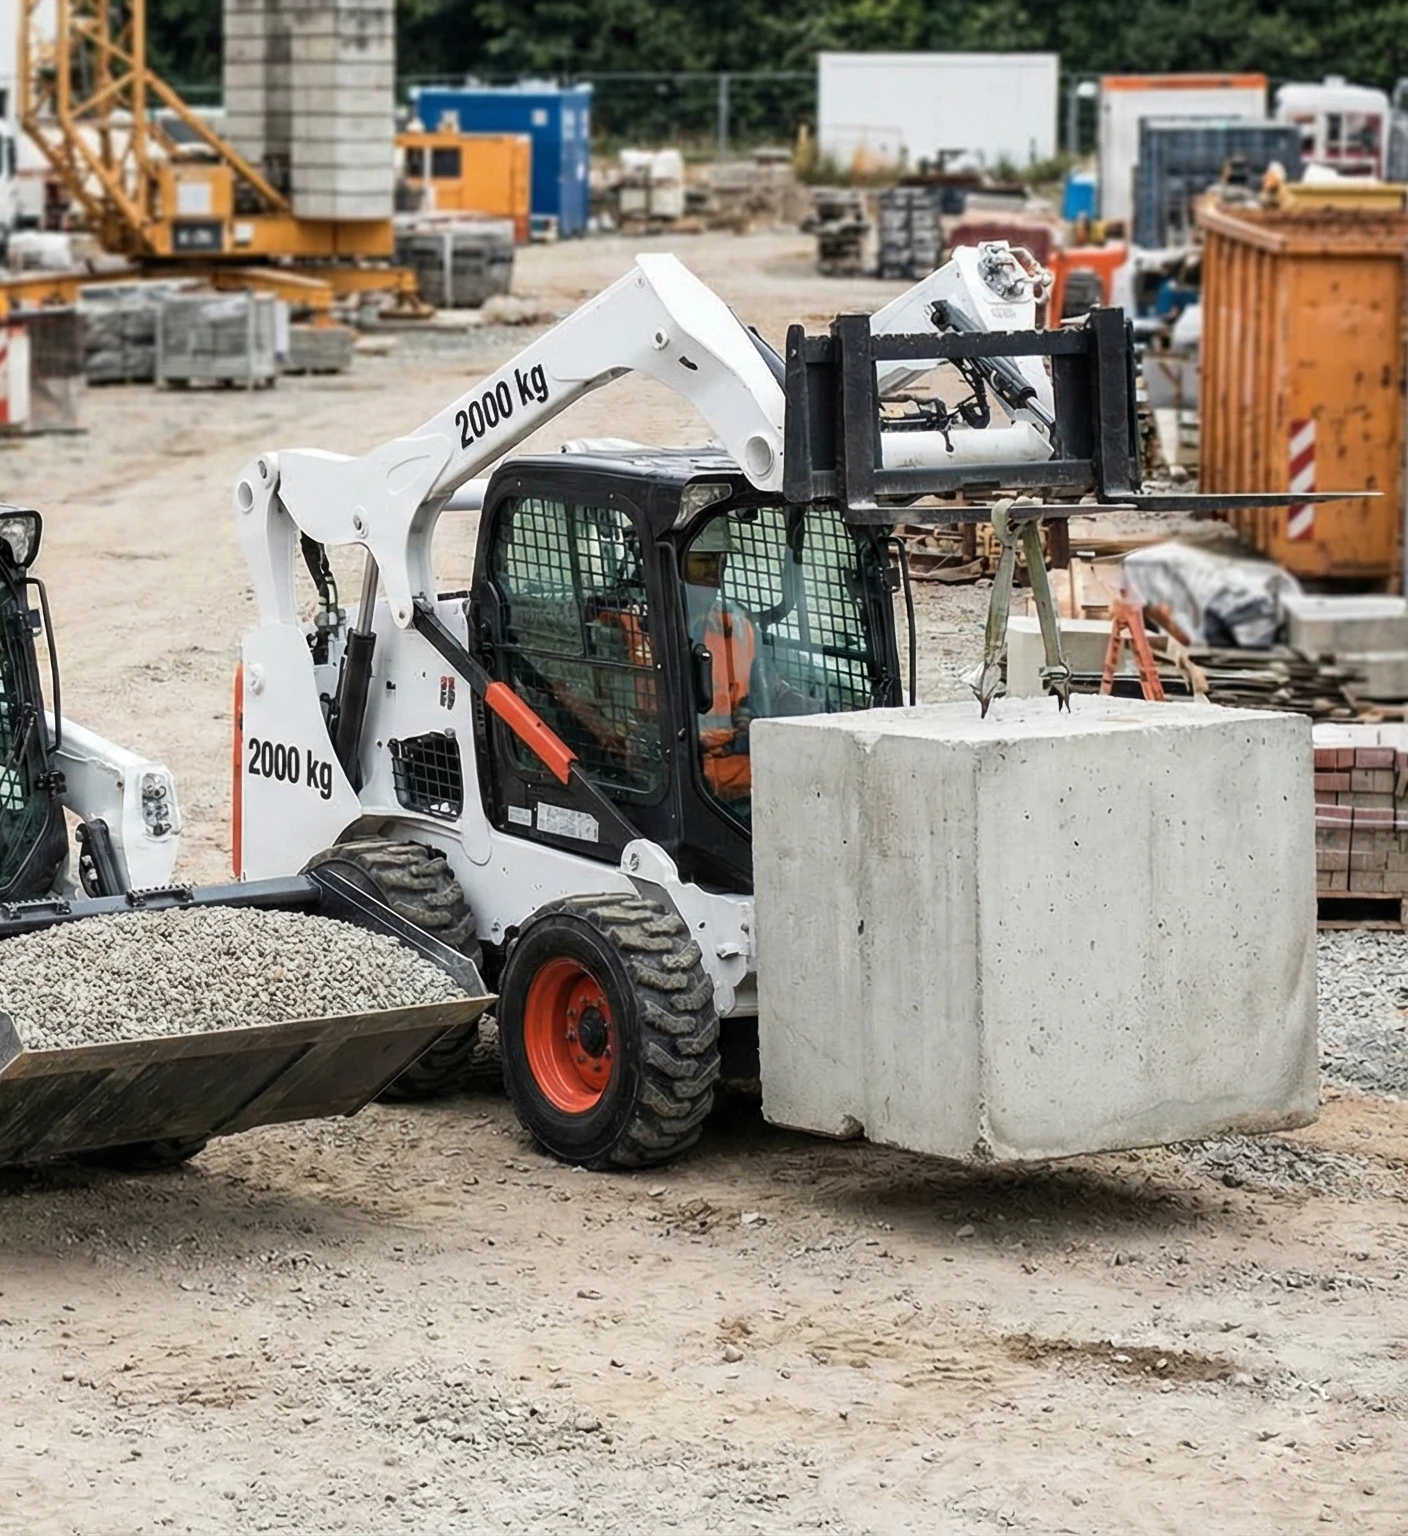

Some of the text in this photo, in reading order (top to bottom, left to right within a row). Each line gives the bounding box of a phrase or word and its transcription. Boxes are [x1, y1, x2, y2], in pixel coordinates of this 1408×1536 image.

[455, 364, 549, 450] 2000 kg
[248, 737, 332, 800] 2000 kg
